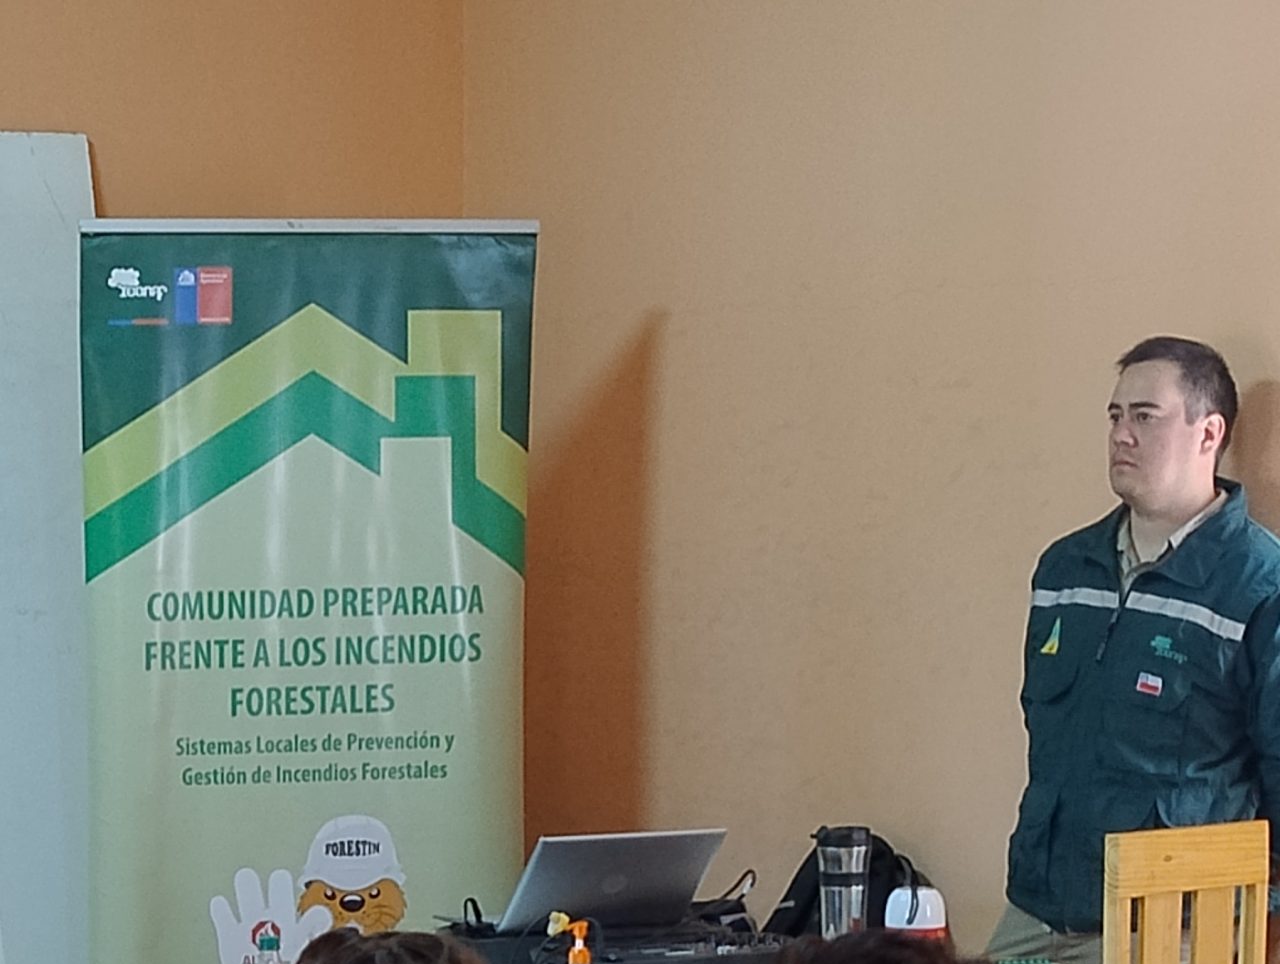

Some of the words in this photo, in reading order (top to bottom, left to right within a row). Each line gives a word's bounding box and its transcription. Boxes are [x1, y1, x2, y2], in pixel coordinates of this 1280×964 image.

[146, 588, 315, 622] COMUNIDAD
[323, 584, 485, 618] PREPARADA
[144, 638, 246, 672] FRENTE
[252, 637, 271, 669] A
[278, 636, 327, 667] LOS
[335, 632, 482, 666] INCENDIOS
[230, 683, 396, 718] FORESTALES
[175, 737, 252, 756] Sistemas
[256, 734, 318, 753] Locales
[321, 733, 342, 751] de
[346, 730, 440, 751] Prevención
[444, 734, 455, 752] y
[182, 766, 247, 786] Gestión
[251, 766, 272, 784] de
[276, 763, 357, 783] Incendios
[361, 760, 448, 780] Forestales
[324, 839, 381, 857] FORESTIN
